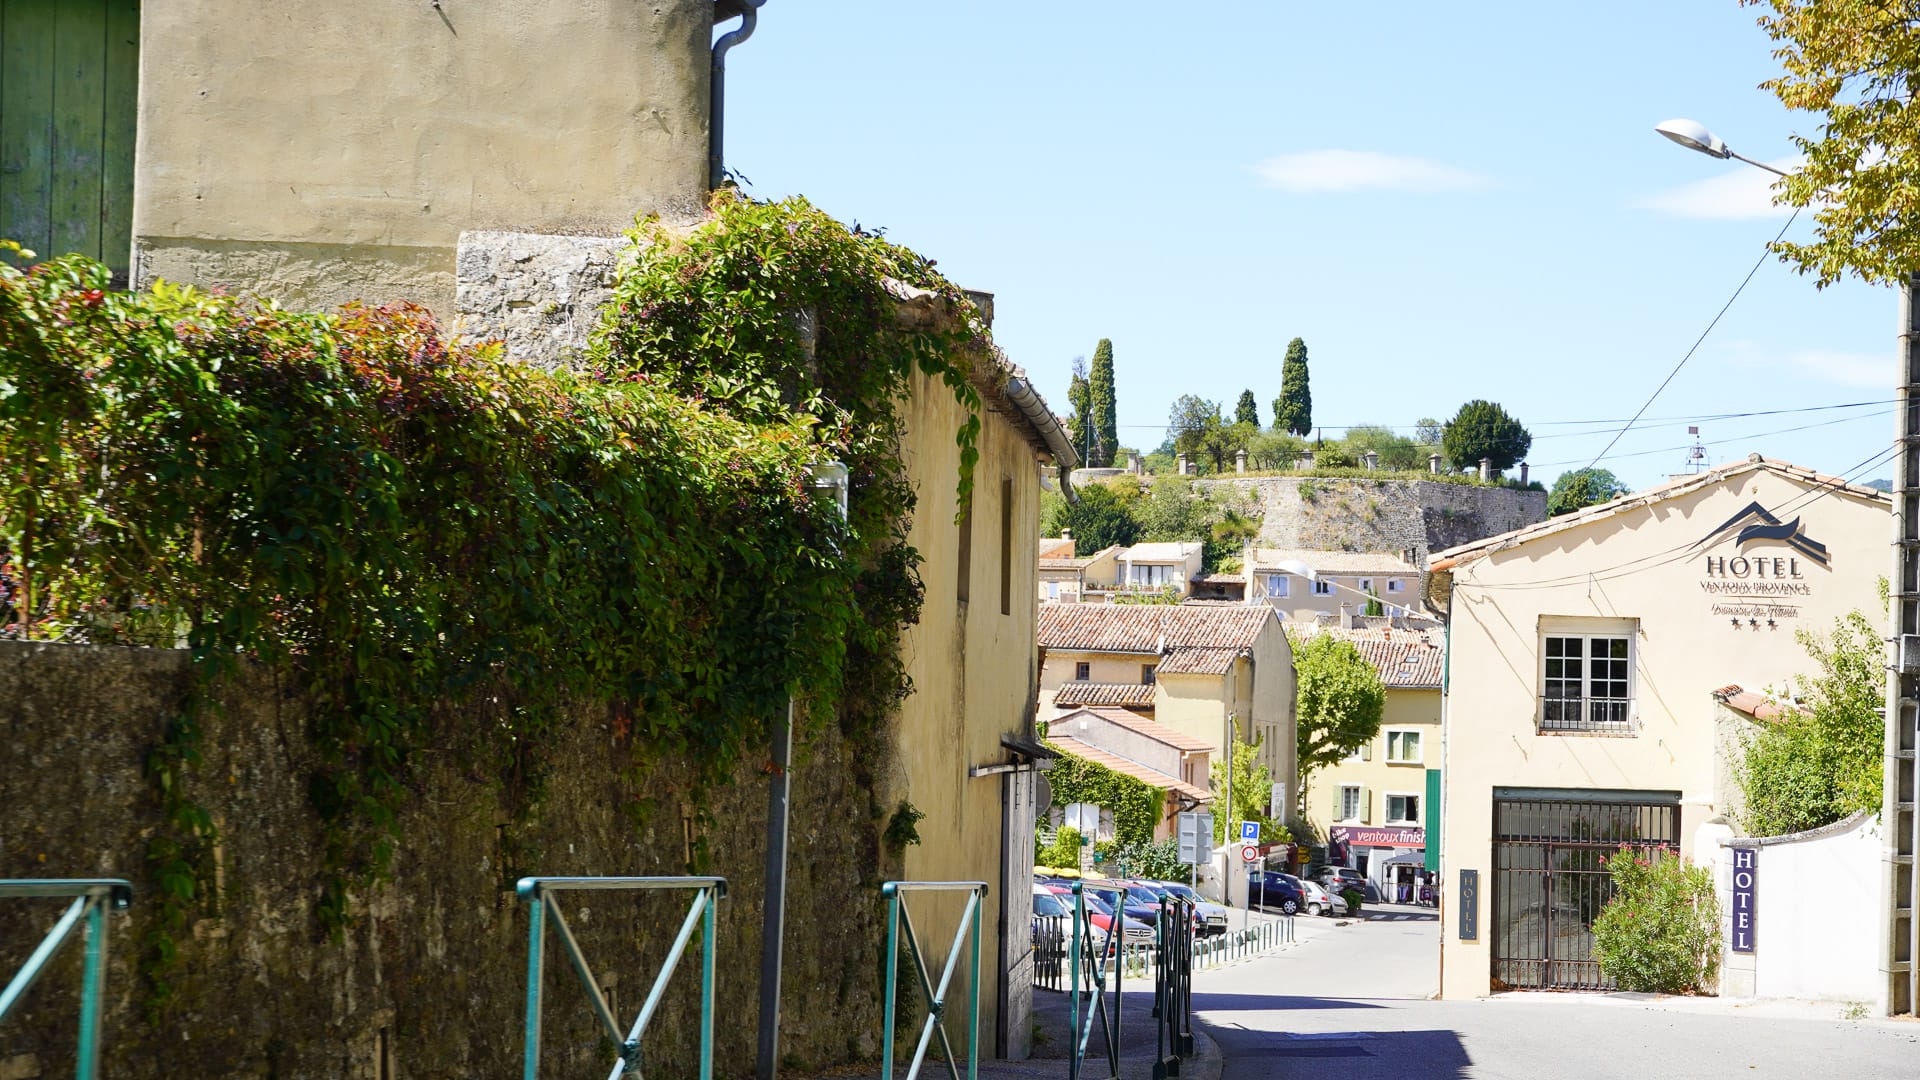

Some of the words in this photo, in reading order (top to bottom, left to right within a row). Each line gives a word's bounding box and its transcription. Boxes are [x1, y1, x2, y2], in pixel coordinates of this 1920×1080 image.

[1706, 556, 1802, 577] HOTEL
[1700, 581, 1751, 592] VENTOUX
[1753, 582, 1809, 594] PROVENCE
[1246, 825, 1254, 836] P
[1357, 831, 1399, 843] ventoux
[1735, 852, 1753, 949] HOTEL
